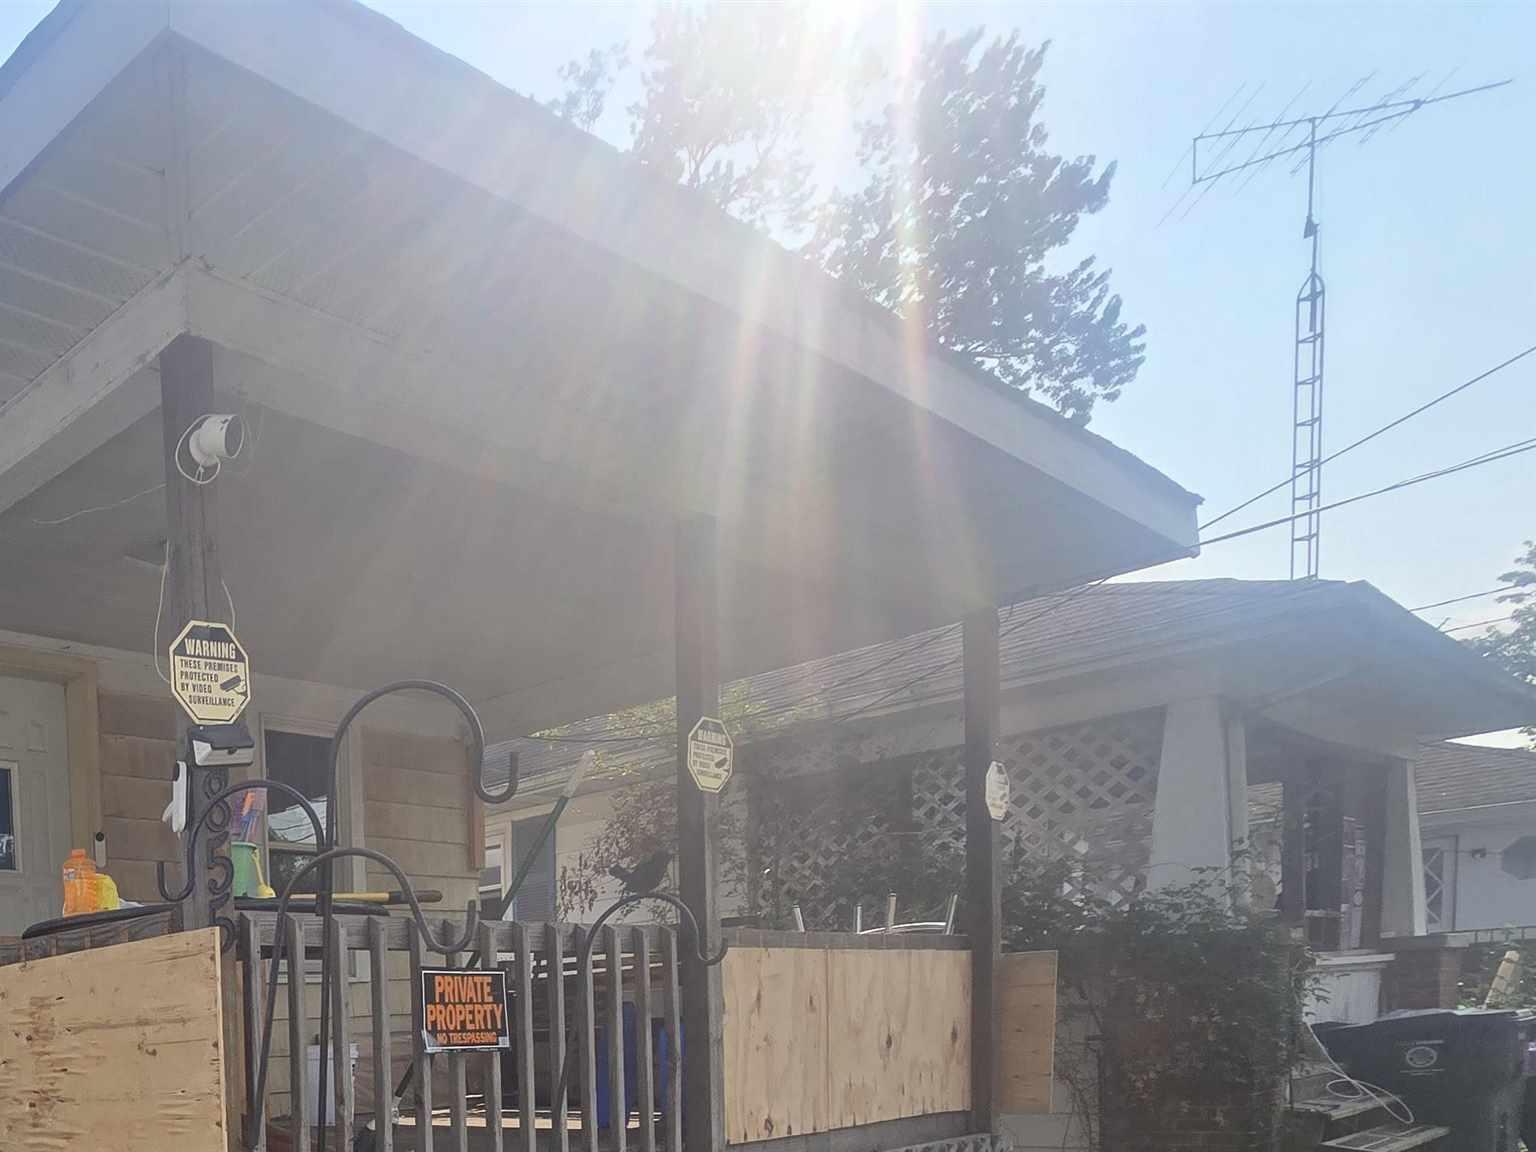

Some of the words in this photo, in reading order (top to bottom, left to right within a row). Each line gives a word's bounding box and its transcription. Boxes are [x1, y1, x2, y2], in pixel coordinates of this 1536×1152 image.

[184, 638, 236, 659] WARNING
[180, 659, 201, 669] THESE
[204, 661, 238, 673] PREMISES
[180, 670, 219, 682] PROTECTED
[181, 682, 189, 691] BY
[192, 683, 212, 693] VIDEO
[188, 695, 235, 706] SURVEILLANCE
[435, 975, 493, 1002] PRIVATE
[426, 1004, 503, 1030] PROPERTY
[436, 1032, 447, 1043] NO
[449, 1031, 497, 1044] TRESPASSING
